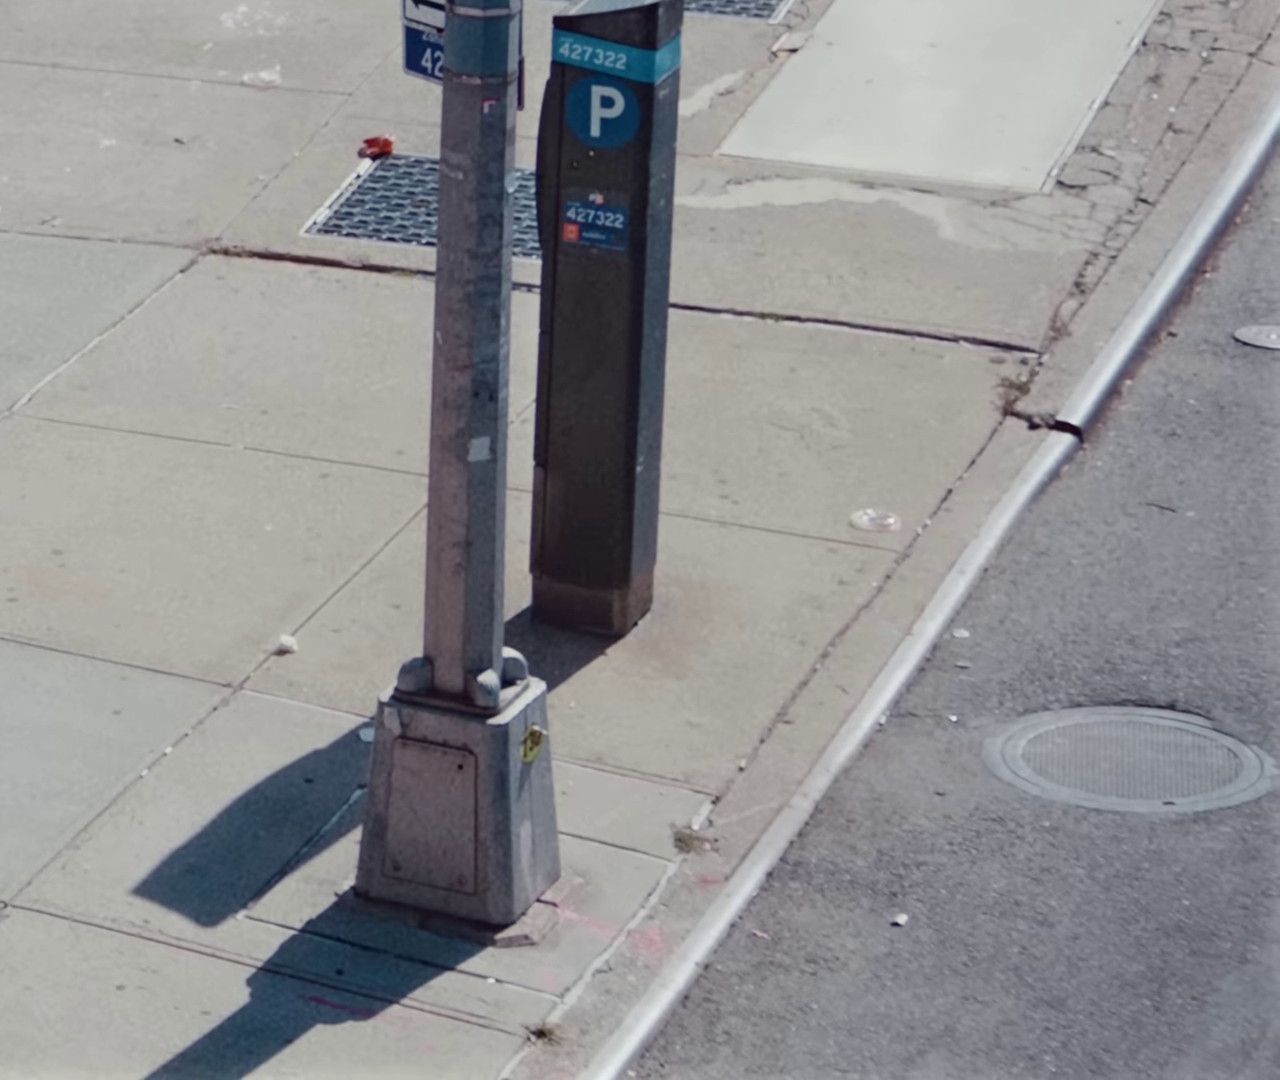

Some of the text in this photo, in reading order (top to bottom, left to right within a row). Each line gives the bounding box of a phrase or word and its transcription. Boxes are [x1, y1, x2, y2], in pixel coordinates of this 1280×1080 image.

[421, 47, 444, 78] 42
[559, 42, 627, 70] 427322
[590, 84, 626, 138] P
[566, 207, 624, 229] 427322
